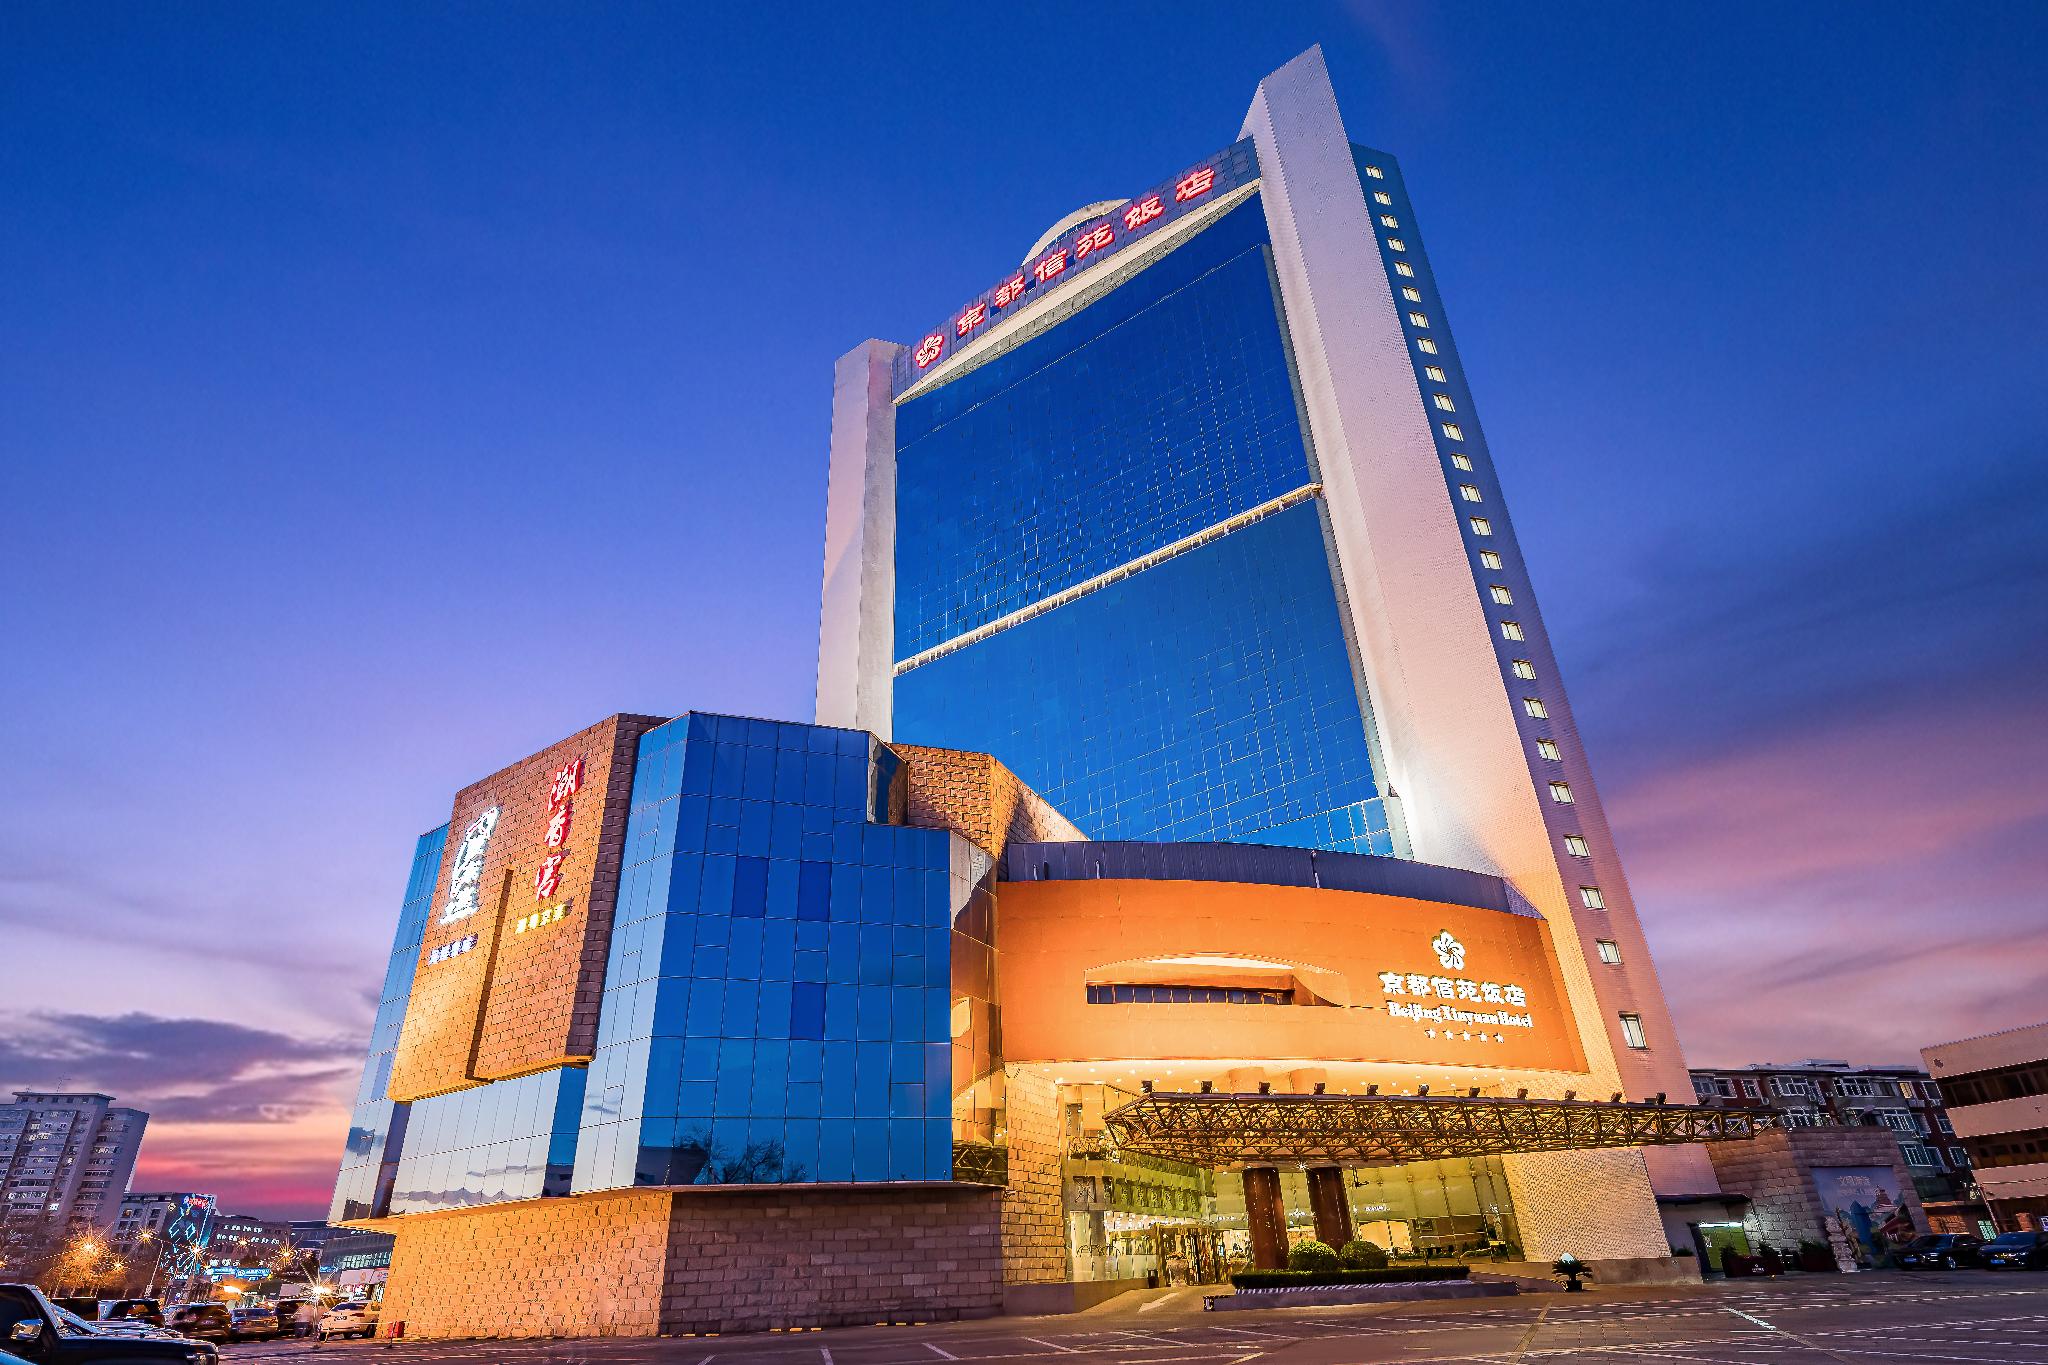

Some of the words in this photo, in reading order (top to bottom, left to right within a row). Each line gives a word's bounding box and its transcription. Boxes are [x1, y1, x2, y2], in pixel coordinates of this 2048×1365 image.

[957, 167, 1214, 337] 京都信苑饭店
[1378, 972, 1527, 1007] 京都信苑饭店
[1386, 1000, 1442, 1023] Beijing
[1496, 1010, 1534, 1028] Hotel
